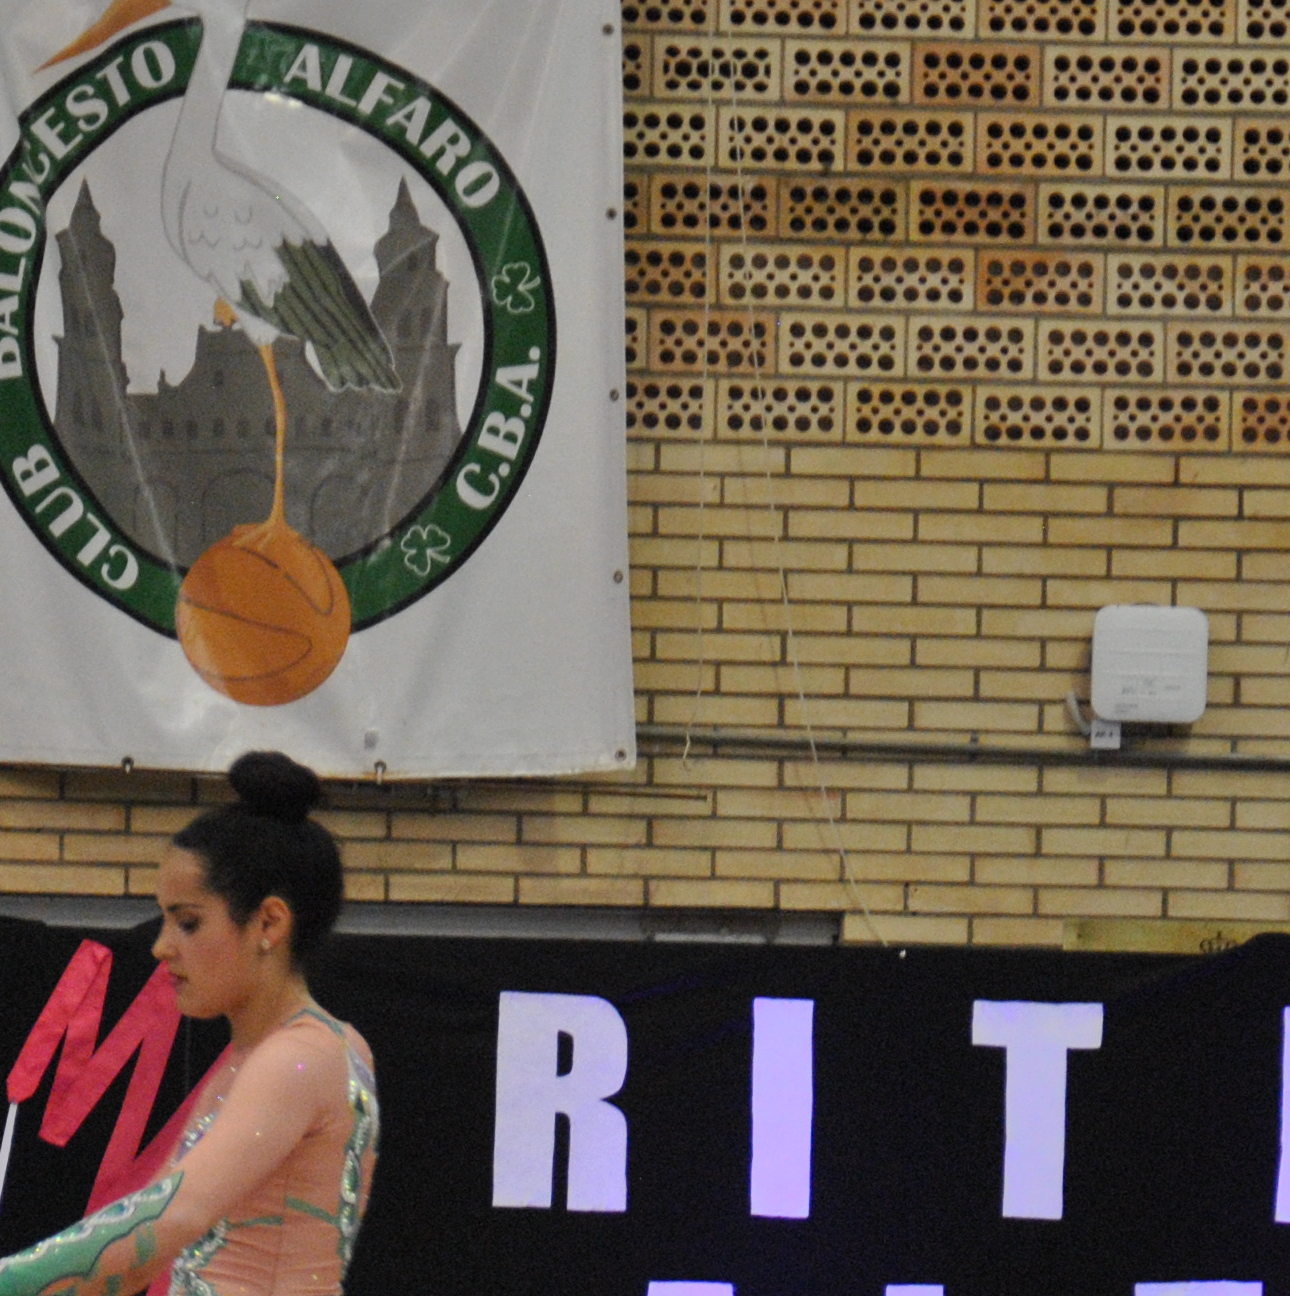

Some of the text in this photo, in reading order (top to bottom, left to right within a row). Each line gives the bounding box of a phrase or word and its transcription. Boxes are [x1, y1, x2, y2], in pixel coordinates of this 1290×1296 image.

[12, 443, 140, 591] CLUB
[284, 43, 501, 210] ALFARO
[454, 345, 542, 512] C.B.A.
